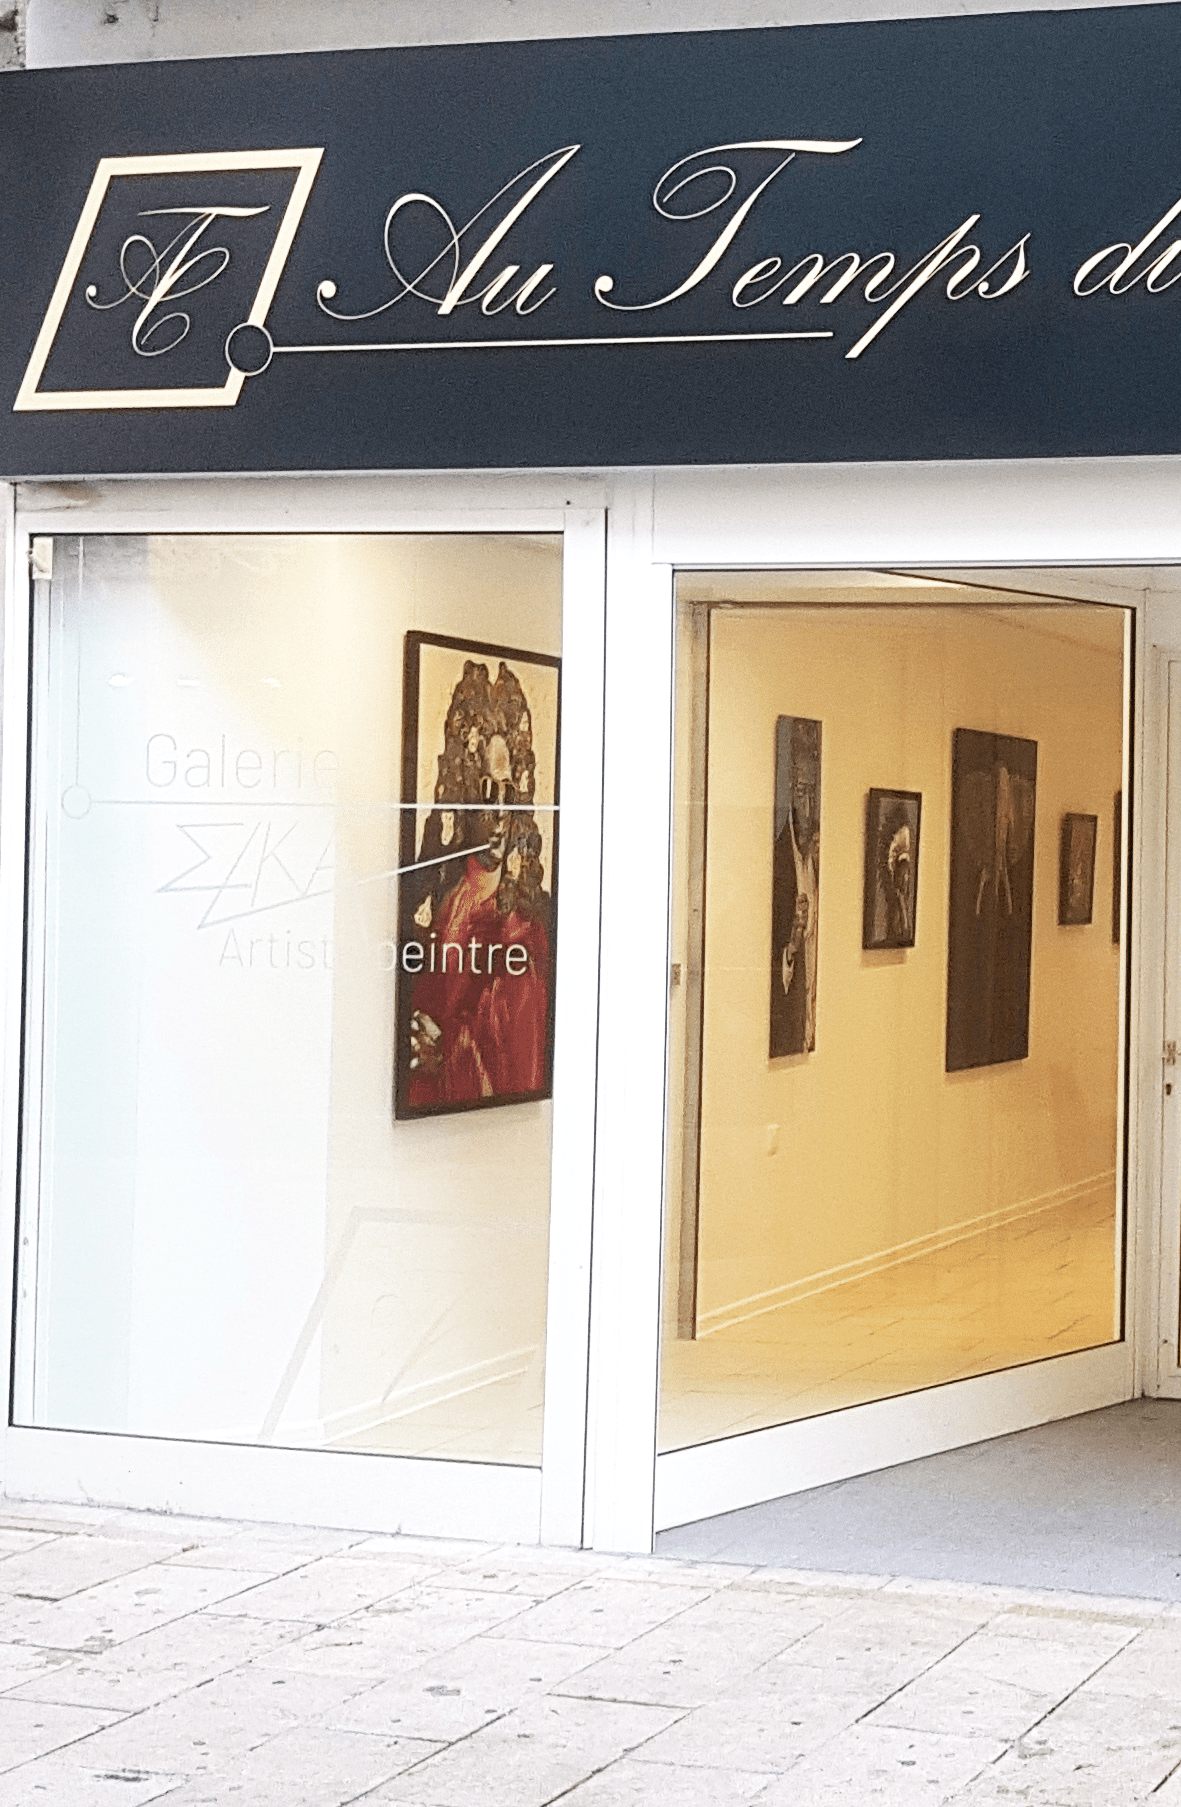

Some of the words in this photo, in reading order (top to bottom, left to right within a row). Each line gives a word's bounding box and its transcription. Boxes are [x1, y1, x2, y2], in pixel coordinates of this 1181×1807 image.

[317, 144, 581, 320] Au
[594, 137, 1031, 359] Temps
[145, 732, 342, 790] Galerie
[218, 927, 336, 971] Artist
